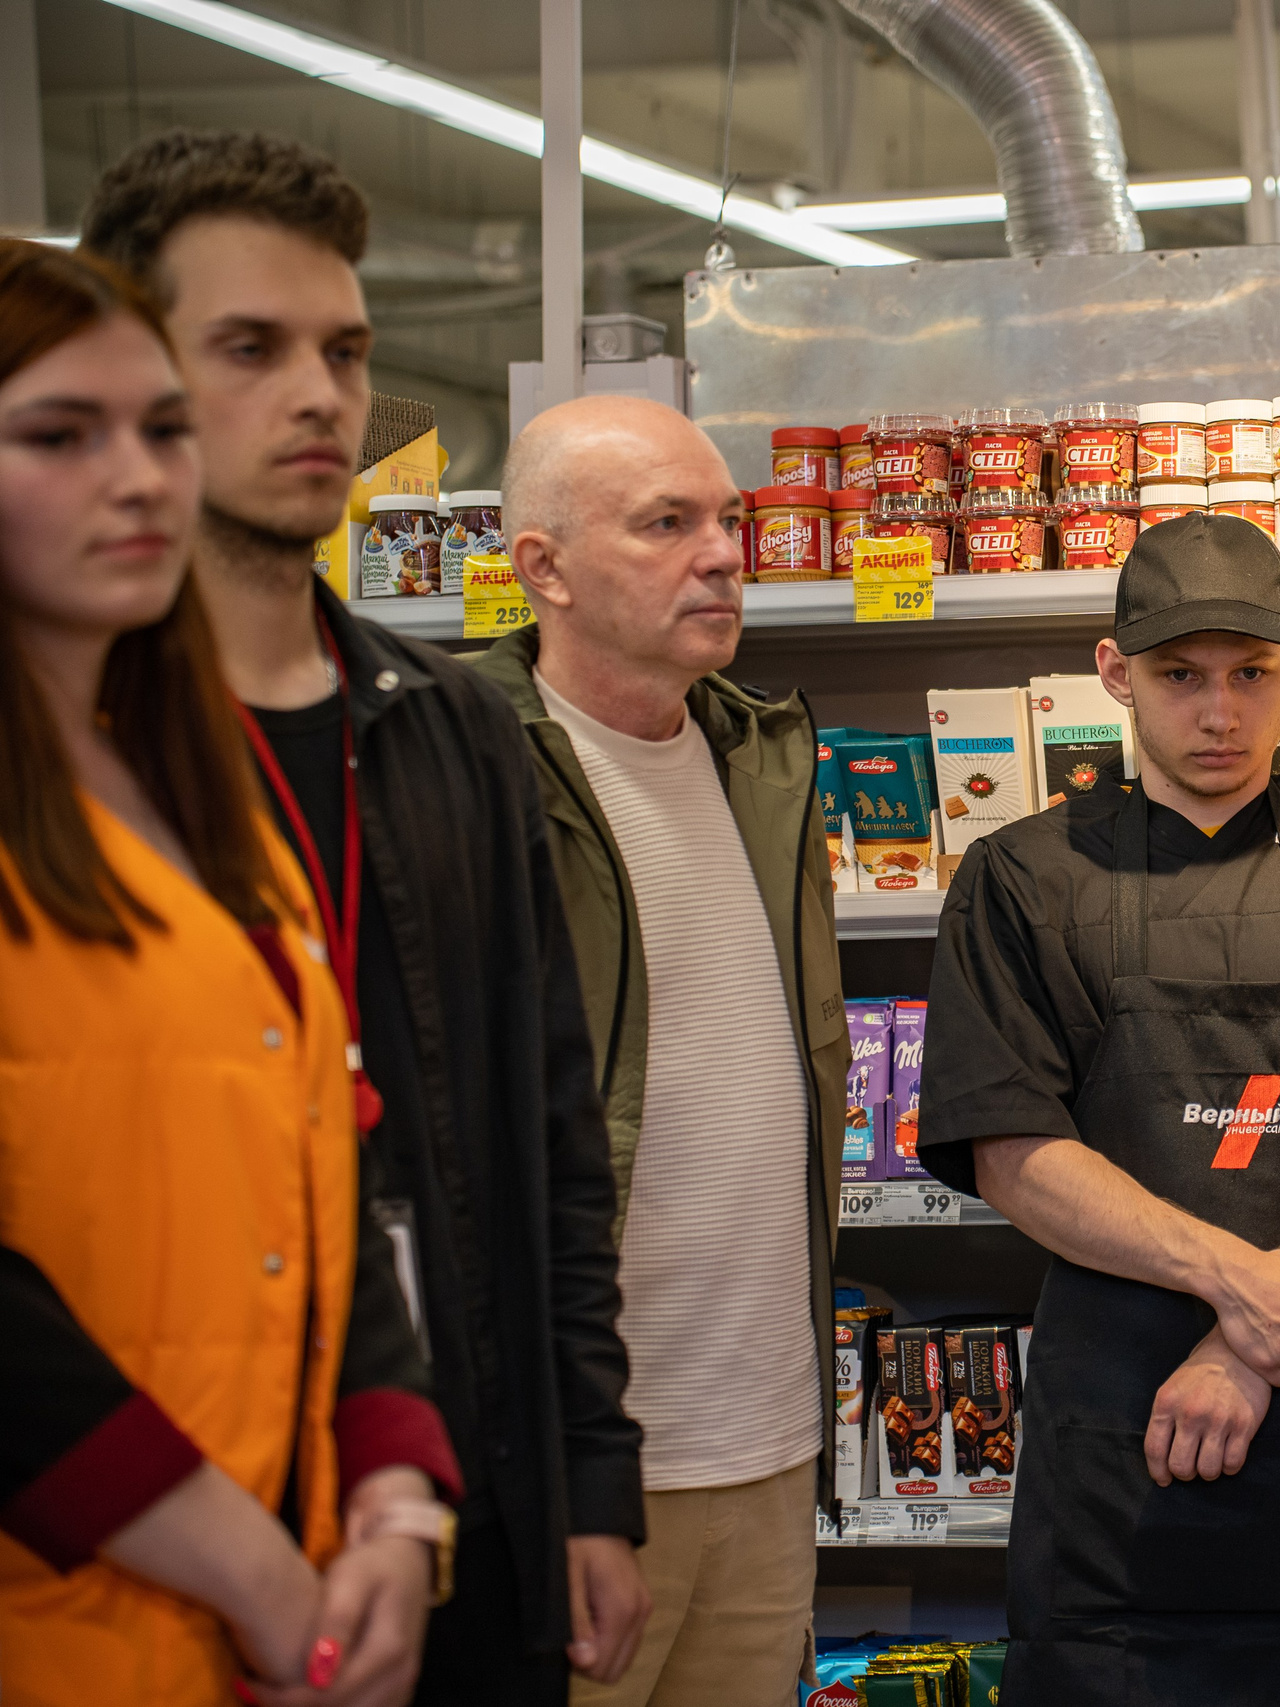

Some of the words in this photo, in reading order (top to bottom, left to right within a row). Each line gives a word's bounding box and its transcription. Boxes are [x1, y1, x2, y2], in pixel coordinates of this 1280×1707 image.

[972, 452, 1018, 467] СТЕП
[1067, 447, 1113, 462] СТЕП
[875, 458, 914, 474] СТЕП
[842, 464, 874, 488] Choos
[759, 525, 813, 553] Choosy
[970, 534, 1014, 550] СТЕП
[1064, 530, 1107, 546] СТЕП
[860, 552, 925, 570] АКЦИЯ!
[470, 570, 519, 586] АКЦИ
[893, 591, 924, 609] 129
[495, 606, 531, 625] 259
[853, 761, 894, 772] Победа
[855, 820, 890, 831] Мишки
[880, 878, 915, 888] Победа
[851, 1037, 885, 1061] lka
[847, 1187, 876, 1195] Выгодно!
[841, 1196, 874, 1214] 109
[923, 1194, 951, 1213] 99
[952, 1194, 960, 1202] 99
[889, 1360, 897, 1379] 72%
[905, 1341, 914, 1396] ШОКОЛАД
[912, 1340, 924, 1396] ГОРЬКИЙ
[926, 1347, 937, 1388] Победа
[958, 1361, 966, 1379] 72%
[972, 1341, 983, 1396] ШОКОЛАД
[980, 1340, 993, 1396] ГОРЬКИЙ
[996, 1346, 1007, 1388] Победа
[899, 1482, 935, 1493] Победа
[973, 1482, 1009, 1493] Победа
[911, 1513, 938, 1531] 119
[939, 1513, 948, 1521] 99
